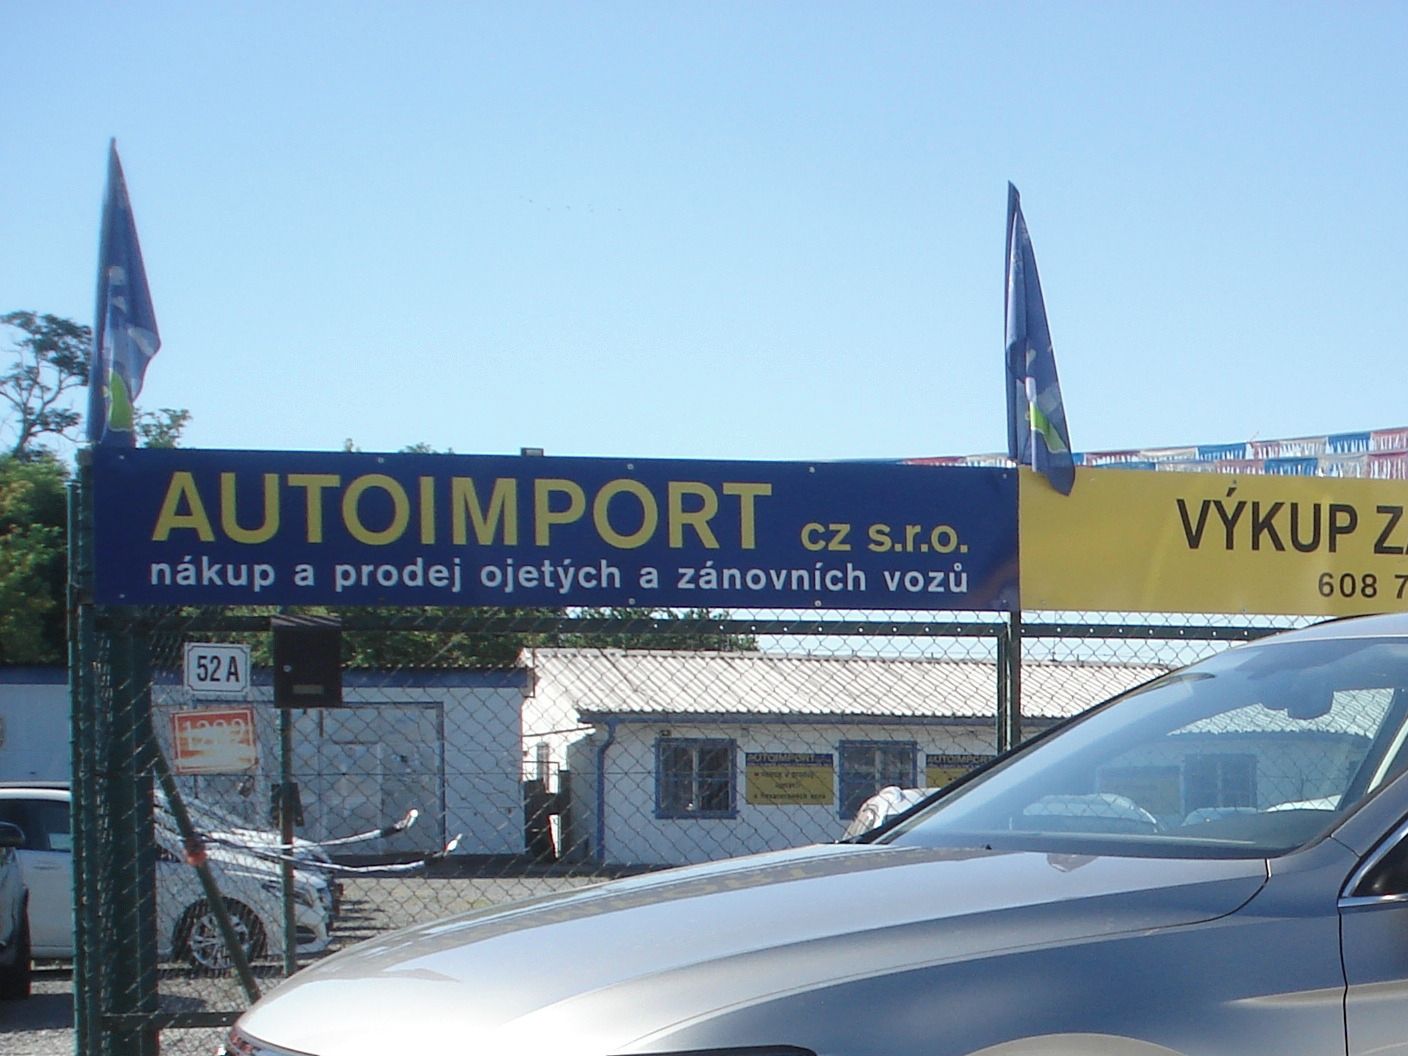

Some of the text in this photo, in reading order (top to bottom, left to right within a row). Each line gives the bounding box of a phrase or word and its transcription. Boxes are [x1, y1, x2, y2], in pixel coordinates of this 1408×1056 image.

[151, 471, 969, 554] AUTOIMPORT cz s.r.o.
[1175, 487, 1359, 553] VÝKUP
[150, 555, 969, 595] nákup a prodej ojetých a zánovních vozů
[1317, 572, 1378, 599] 608
[196, 655, 241, 683] 52 A
